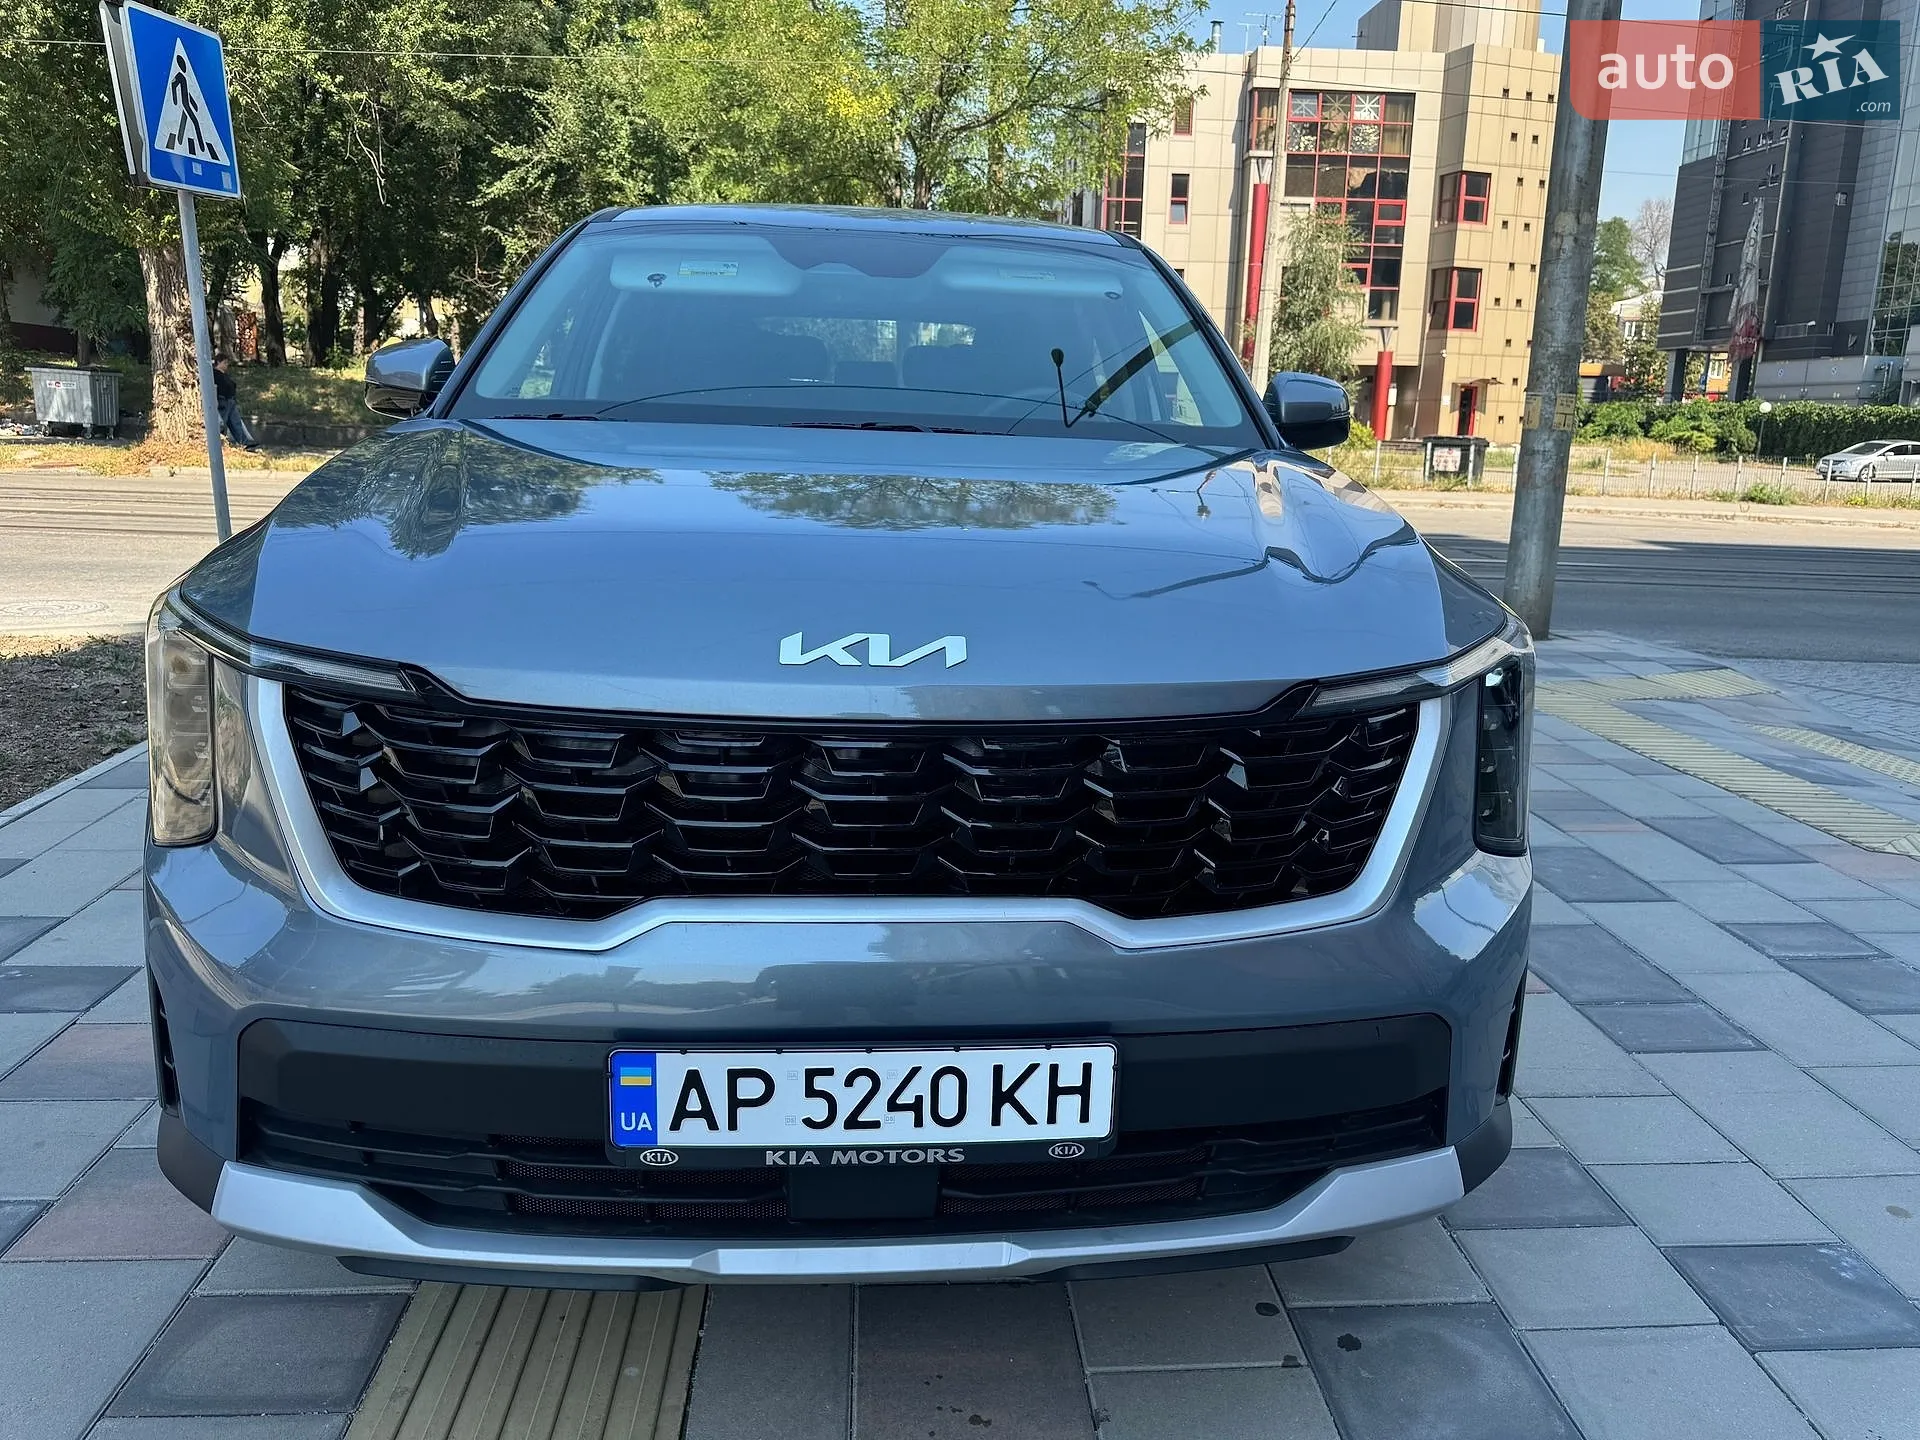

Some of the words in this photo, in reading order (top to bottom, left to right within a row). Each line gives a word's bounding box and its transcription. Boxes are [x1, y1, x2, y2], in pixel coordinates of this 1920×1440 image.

[779, 631, 967, 669] KIA
[668, 1067, 776, 1132] AP
[801, 1065, 969, 1131] 5240
[991, 1062, 1092, 1128] KH
[620, 1112, 652, 1132] UA
[765, 1150, 820, 1166] KIA
[830, 1148, 966, 1165] MOTORS
